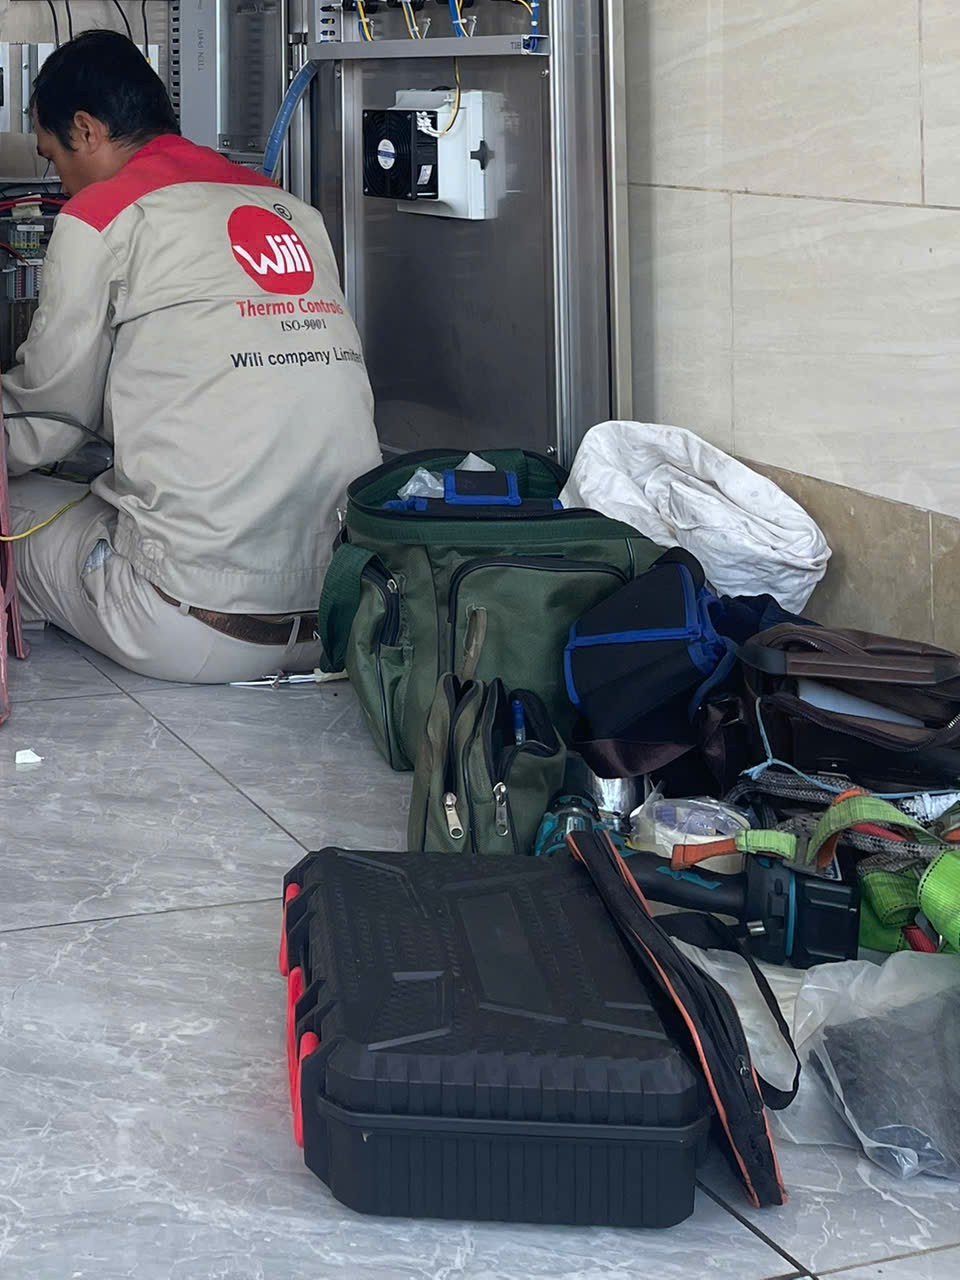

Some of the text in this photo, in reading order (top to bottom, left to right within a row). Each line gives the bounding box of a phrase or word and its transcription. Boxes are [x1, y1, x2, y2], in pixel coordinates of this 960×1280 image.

[236, 298, 344, 317] Thermo Controls
[281, 319, 327, 332] ISO-9001
[230, 351, 264, 368] Wili
[268, 349, 330, 366] company
